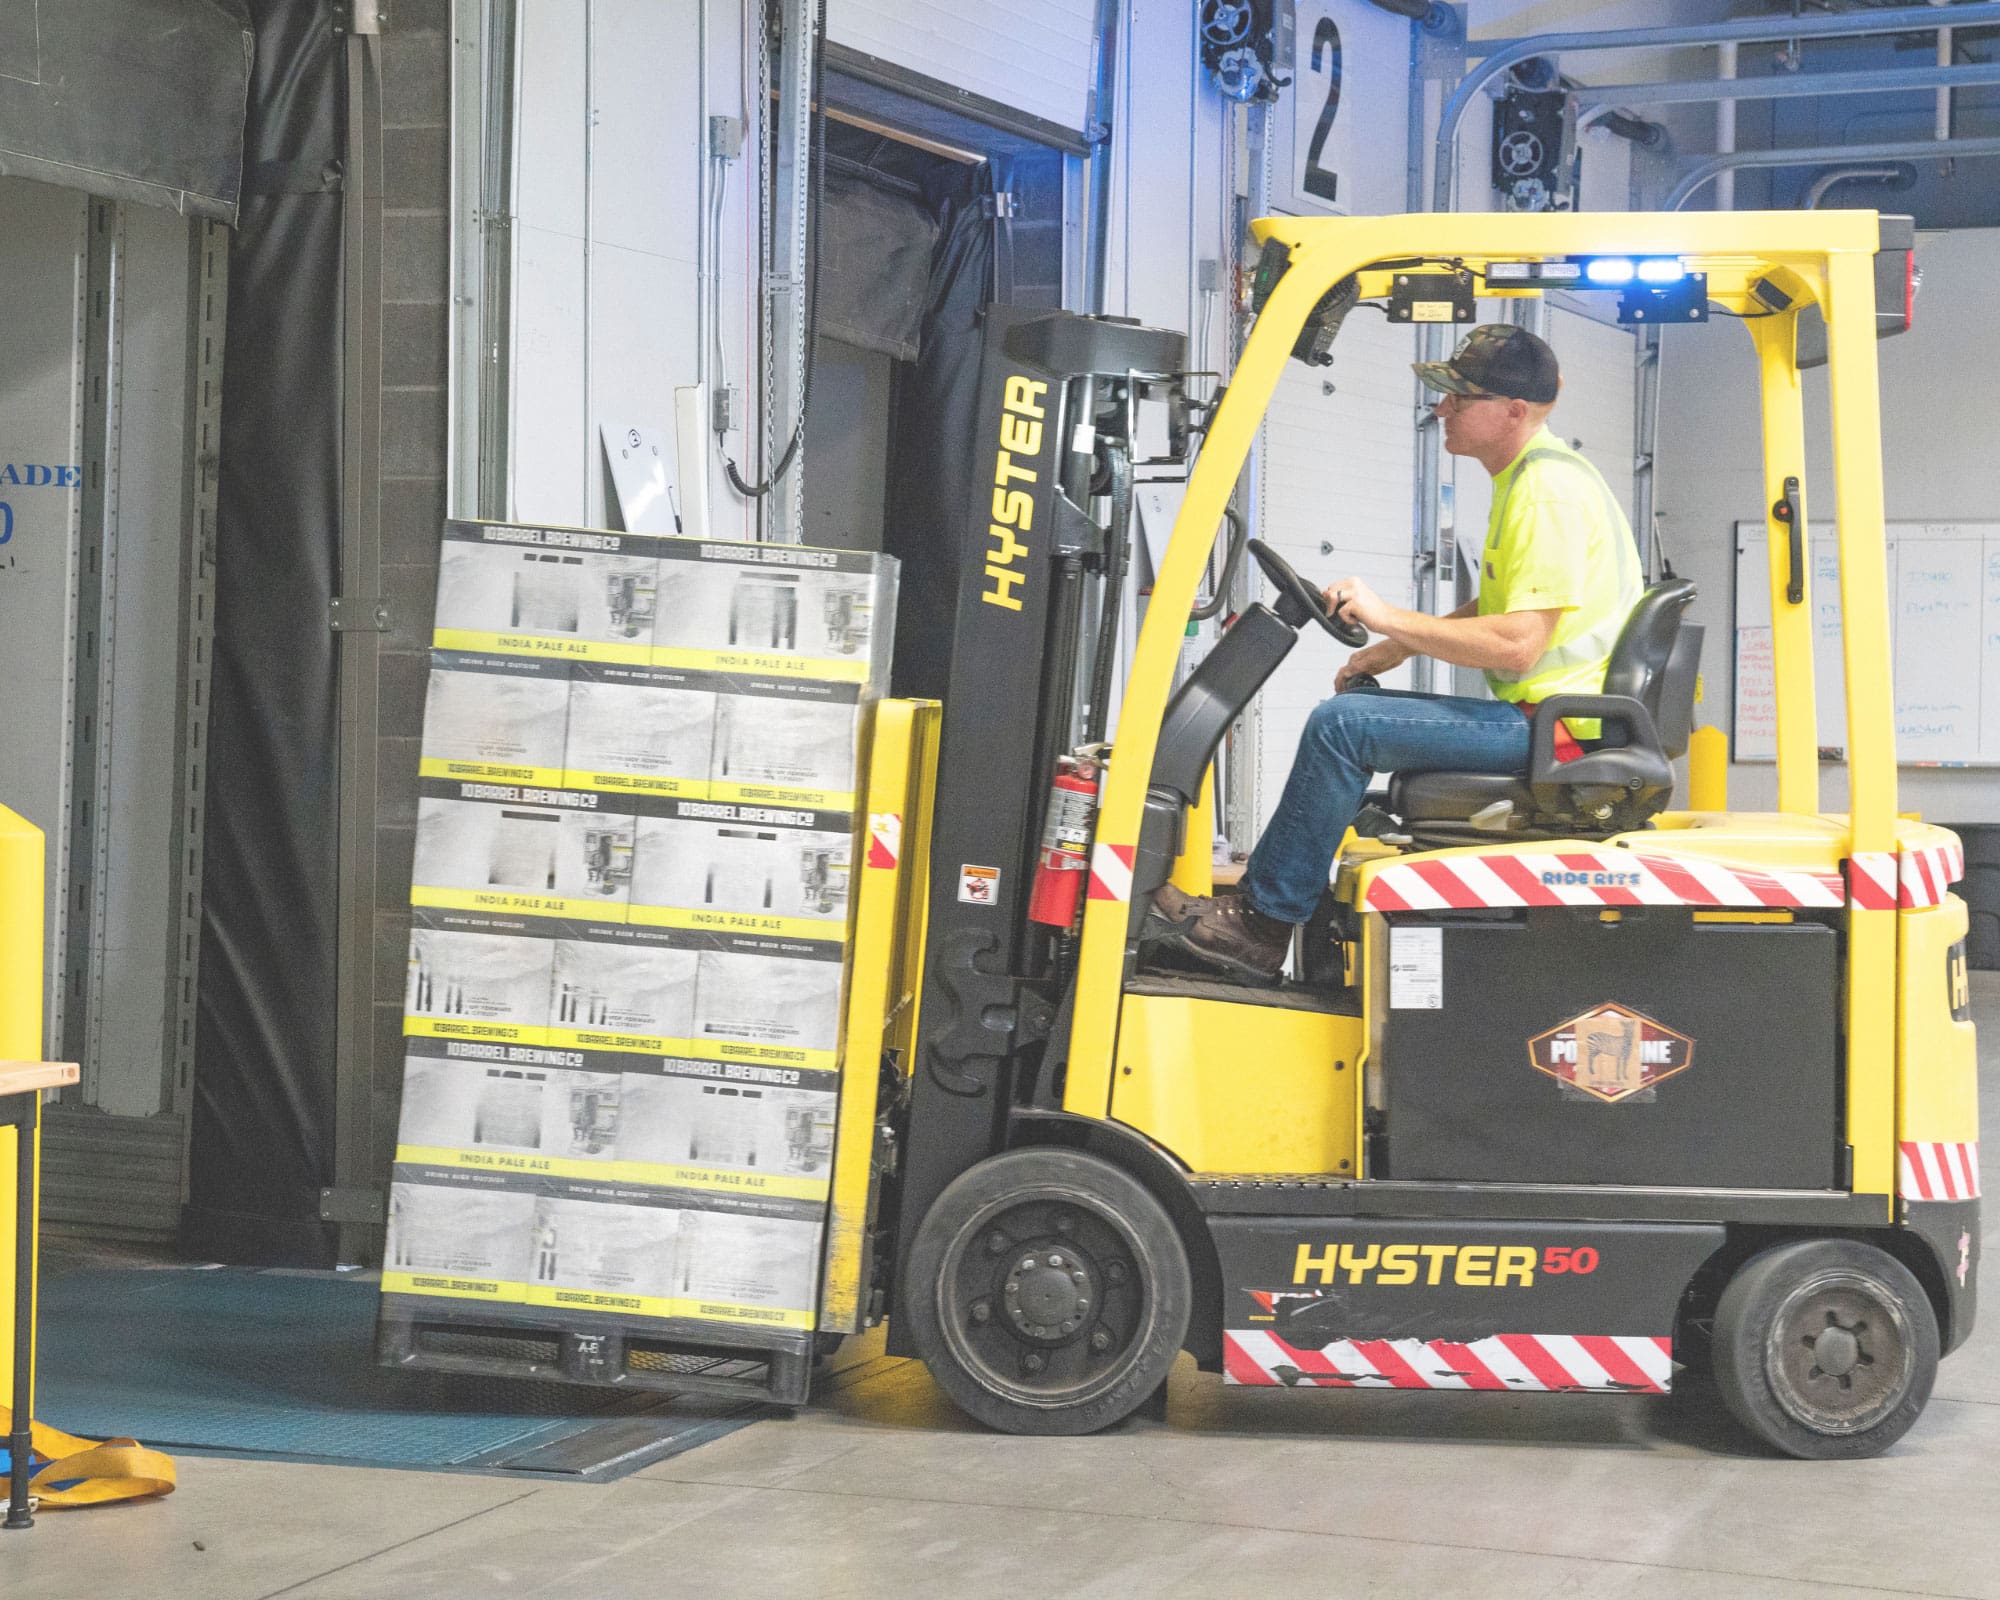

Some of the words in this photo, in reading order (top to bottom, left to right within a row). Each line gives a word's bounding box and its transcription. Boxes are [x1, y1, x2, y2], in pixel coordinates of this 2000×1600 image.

[1303, 17, 1342, 202] 2
[982, 375, 1048, 611] HYSTER
[497, 637, 531, 649] INDIA
[535, 640, 562, 651] PALE
[567, 642, 587, 653] ALE
[1542, 871, 1588, 885] RIDE
[475, 894, 508, 906] INDIA
[513, 897, 539, 908] PALE
[544, 899, 564, 910] ALE
[692, 913, 725, 925] INDIA
[729, 916, 756, 927] PALE
[761, 918, 781, 929] ALE
[459, 1152, 493, 1165] INDIA
[498, 1156, 525, 1168] PALE
[530, 1158, 550, 1170] ALE
[675, 1169, 709, 1182] INDIA
[713, 1172, 740, 1184] PALE
[745, 1175, 766, 1187] ALE
[1292, 1243, 1537, 1287] HYSTER
[1542, 1246, 1600, 1275] 50
